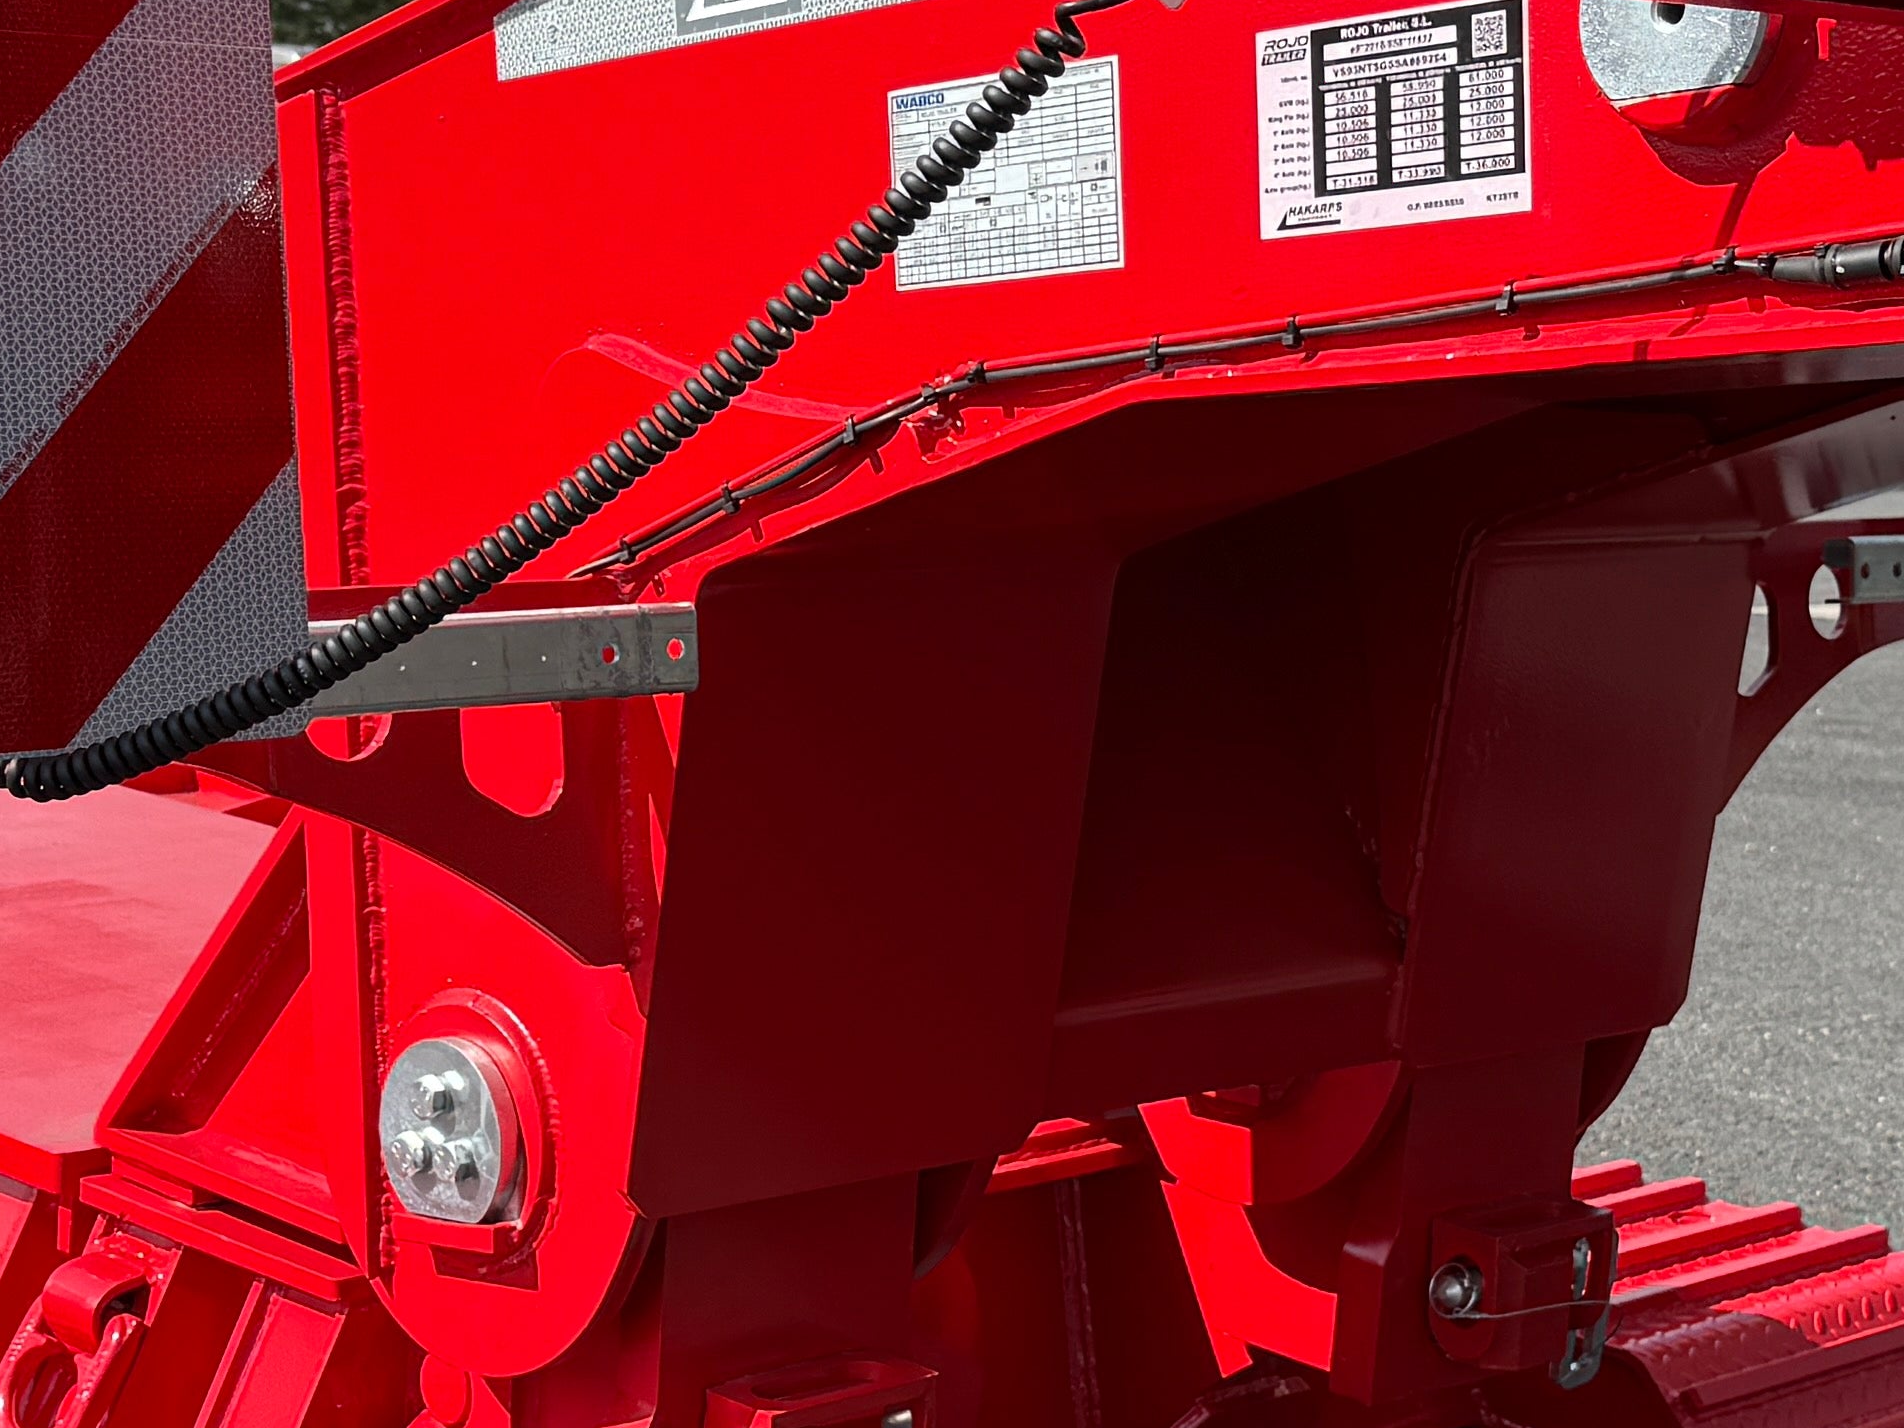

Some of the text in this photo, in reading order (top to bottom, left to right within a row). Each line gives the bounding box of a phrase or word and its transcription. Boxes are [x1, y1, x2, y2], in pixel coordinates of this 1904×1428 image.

[1340, 25, 1369, 39] ROJO
[1263, 35, 1309, 53] ROJO
[1469, 69, 1504, 82] 61.000
[1470, 84, 1505, 98] 25.000
[895, 92, 945, 110] WABCO
[1470, 98, 1505, 112] 12.000
[1470, 113, 1505, 127] 12.000
[1471, 128, 1505, 141] 12.000
[1288, 201, 1343, 217] HAKARPS
